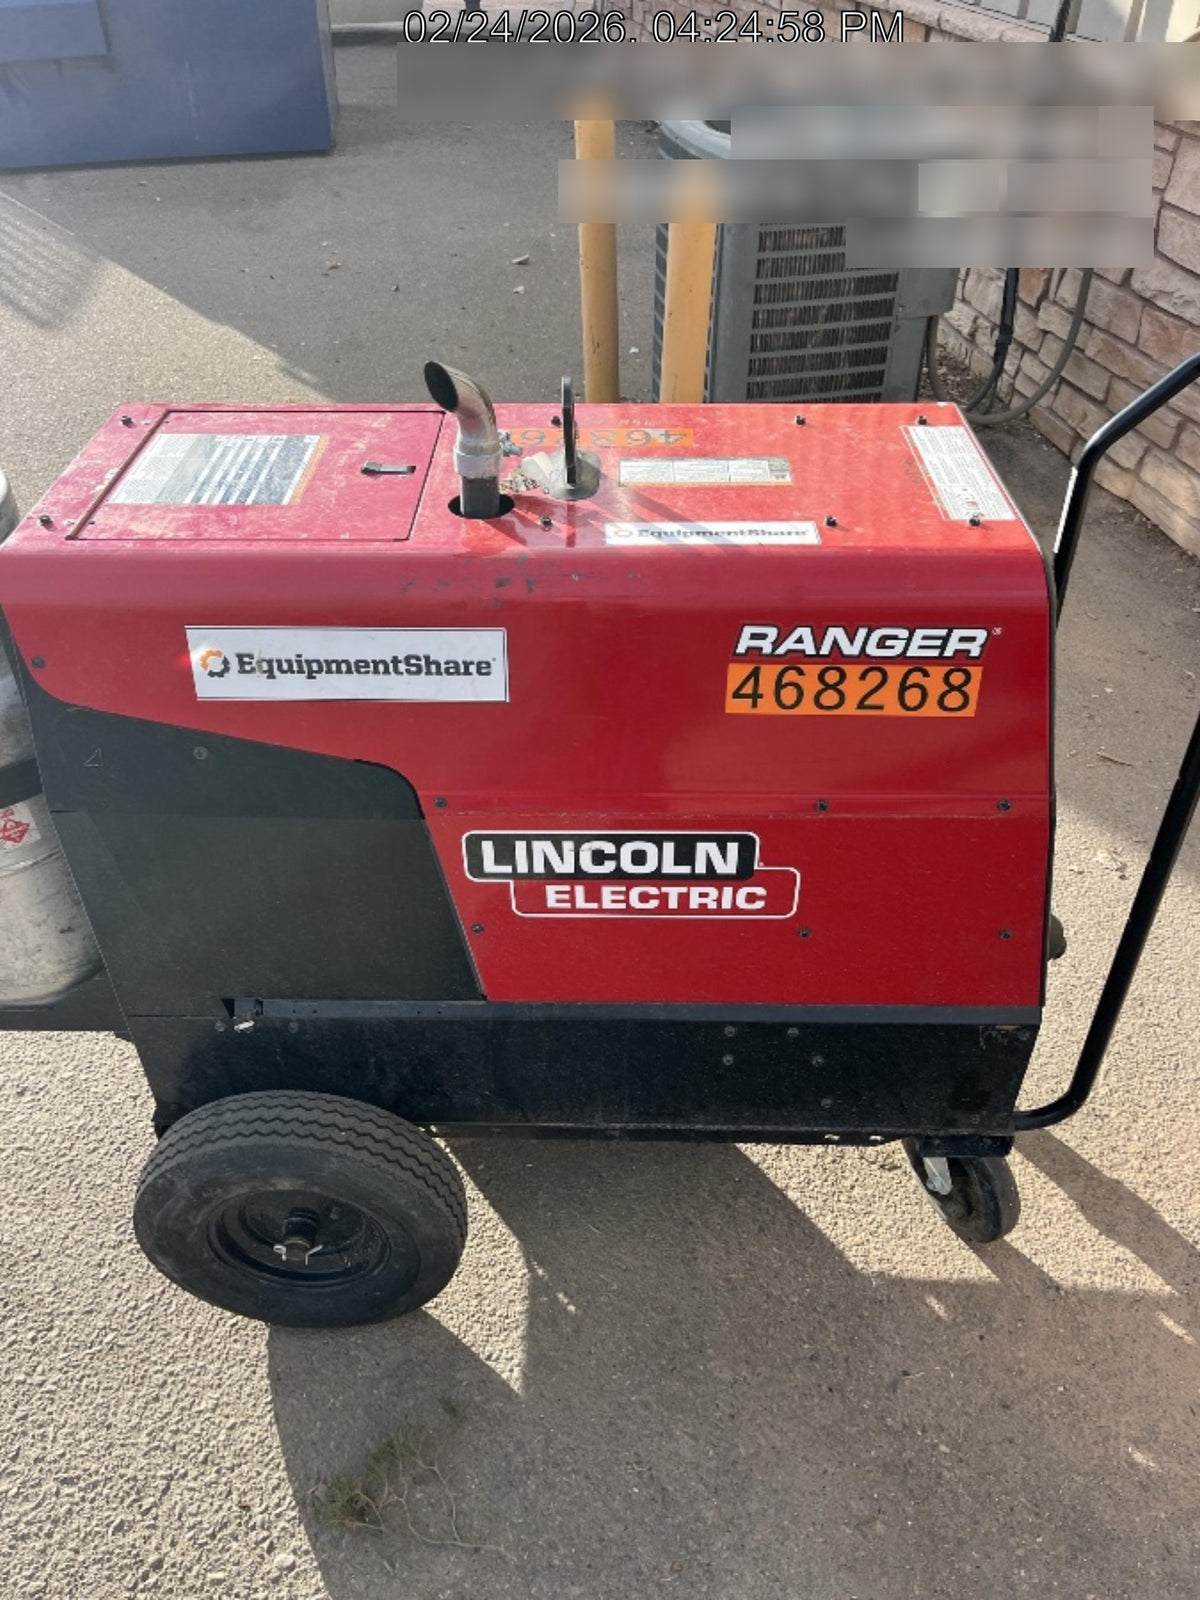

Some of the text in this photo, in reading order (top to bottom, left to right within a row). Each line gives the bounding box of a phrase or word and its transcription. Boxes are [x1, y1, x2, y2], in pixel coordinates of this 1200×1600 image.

[236, 653, 494, 679] EquipmentShare
[731, 665, 973, 712] 468268
[481, 840, 739, 875] LINCOLN
[545, 884, 767, 911] ELECTRIC
